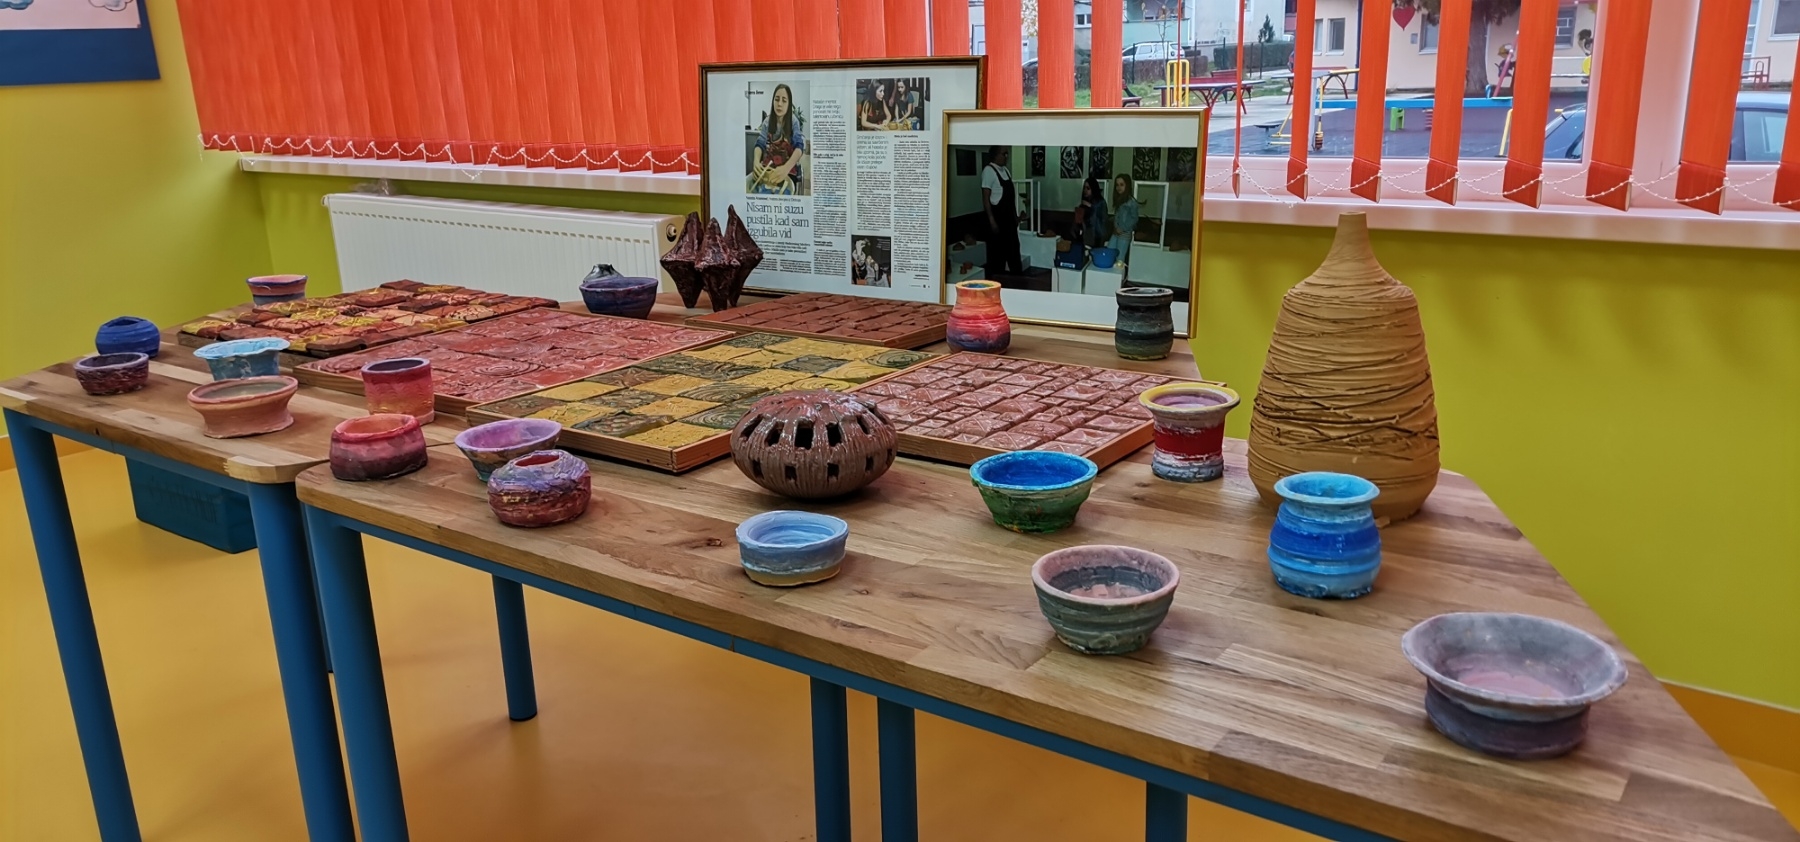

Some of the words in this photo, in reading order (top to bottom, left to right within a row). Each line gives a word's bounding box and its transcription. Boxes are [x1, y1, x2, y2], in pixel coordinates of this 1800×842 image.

[746, 202, 772, 213] Nisam
[774, 203, 782, 213] ni
[784, 206, 804, 214] suzu
[746, 215, 773, 227] pustila
[775, 215, 789, 226] kad
[791, 218, 809, 227] sam
[747, 226, 778, 239] izgubila
[779, 228, 792, 238] vid
